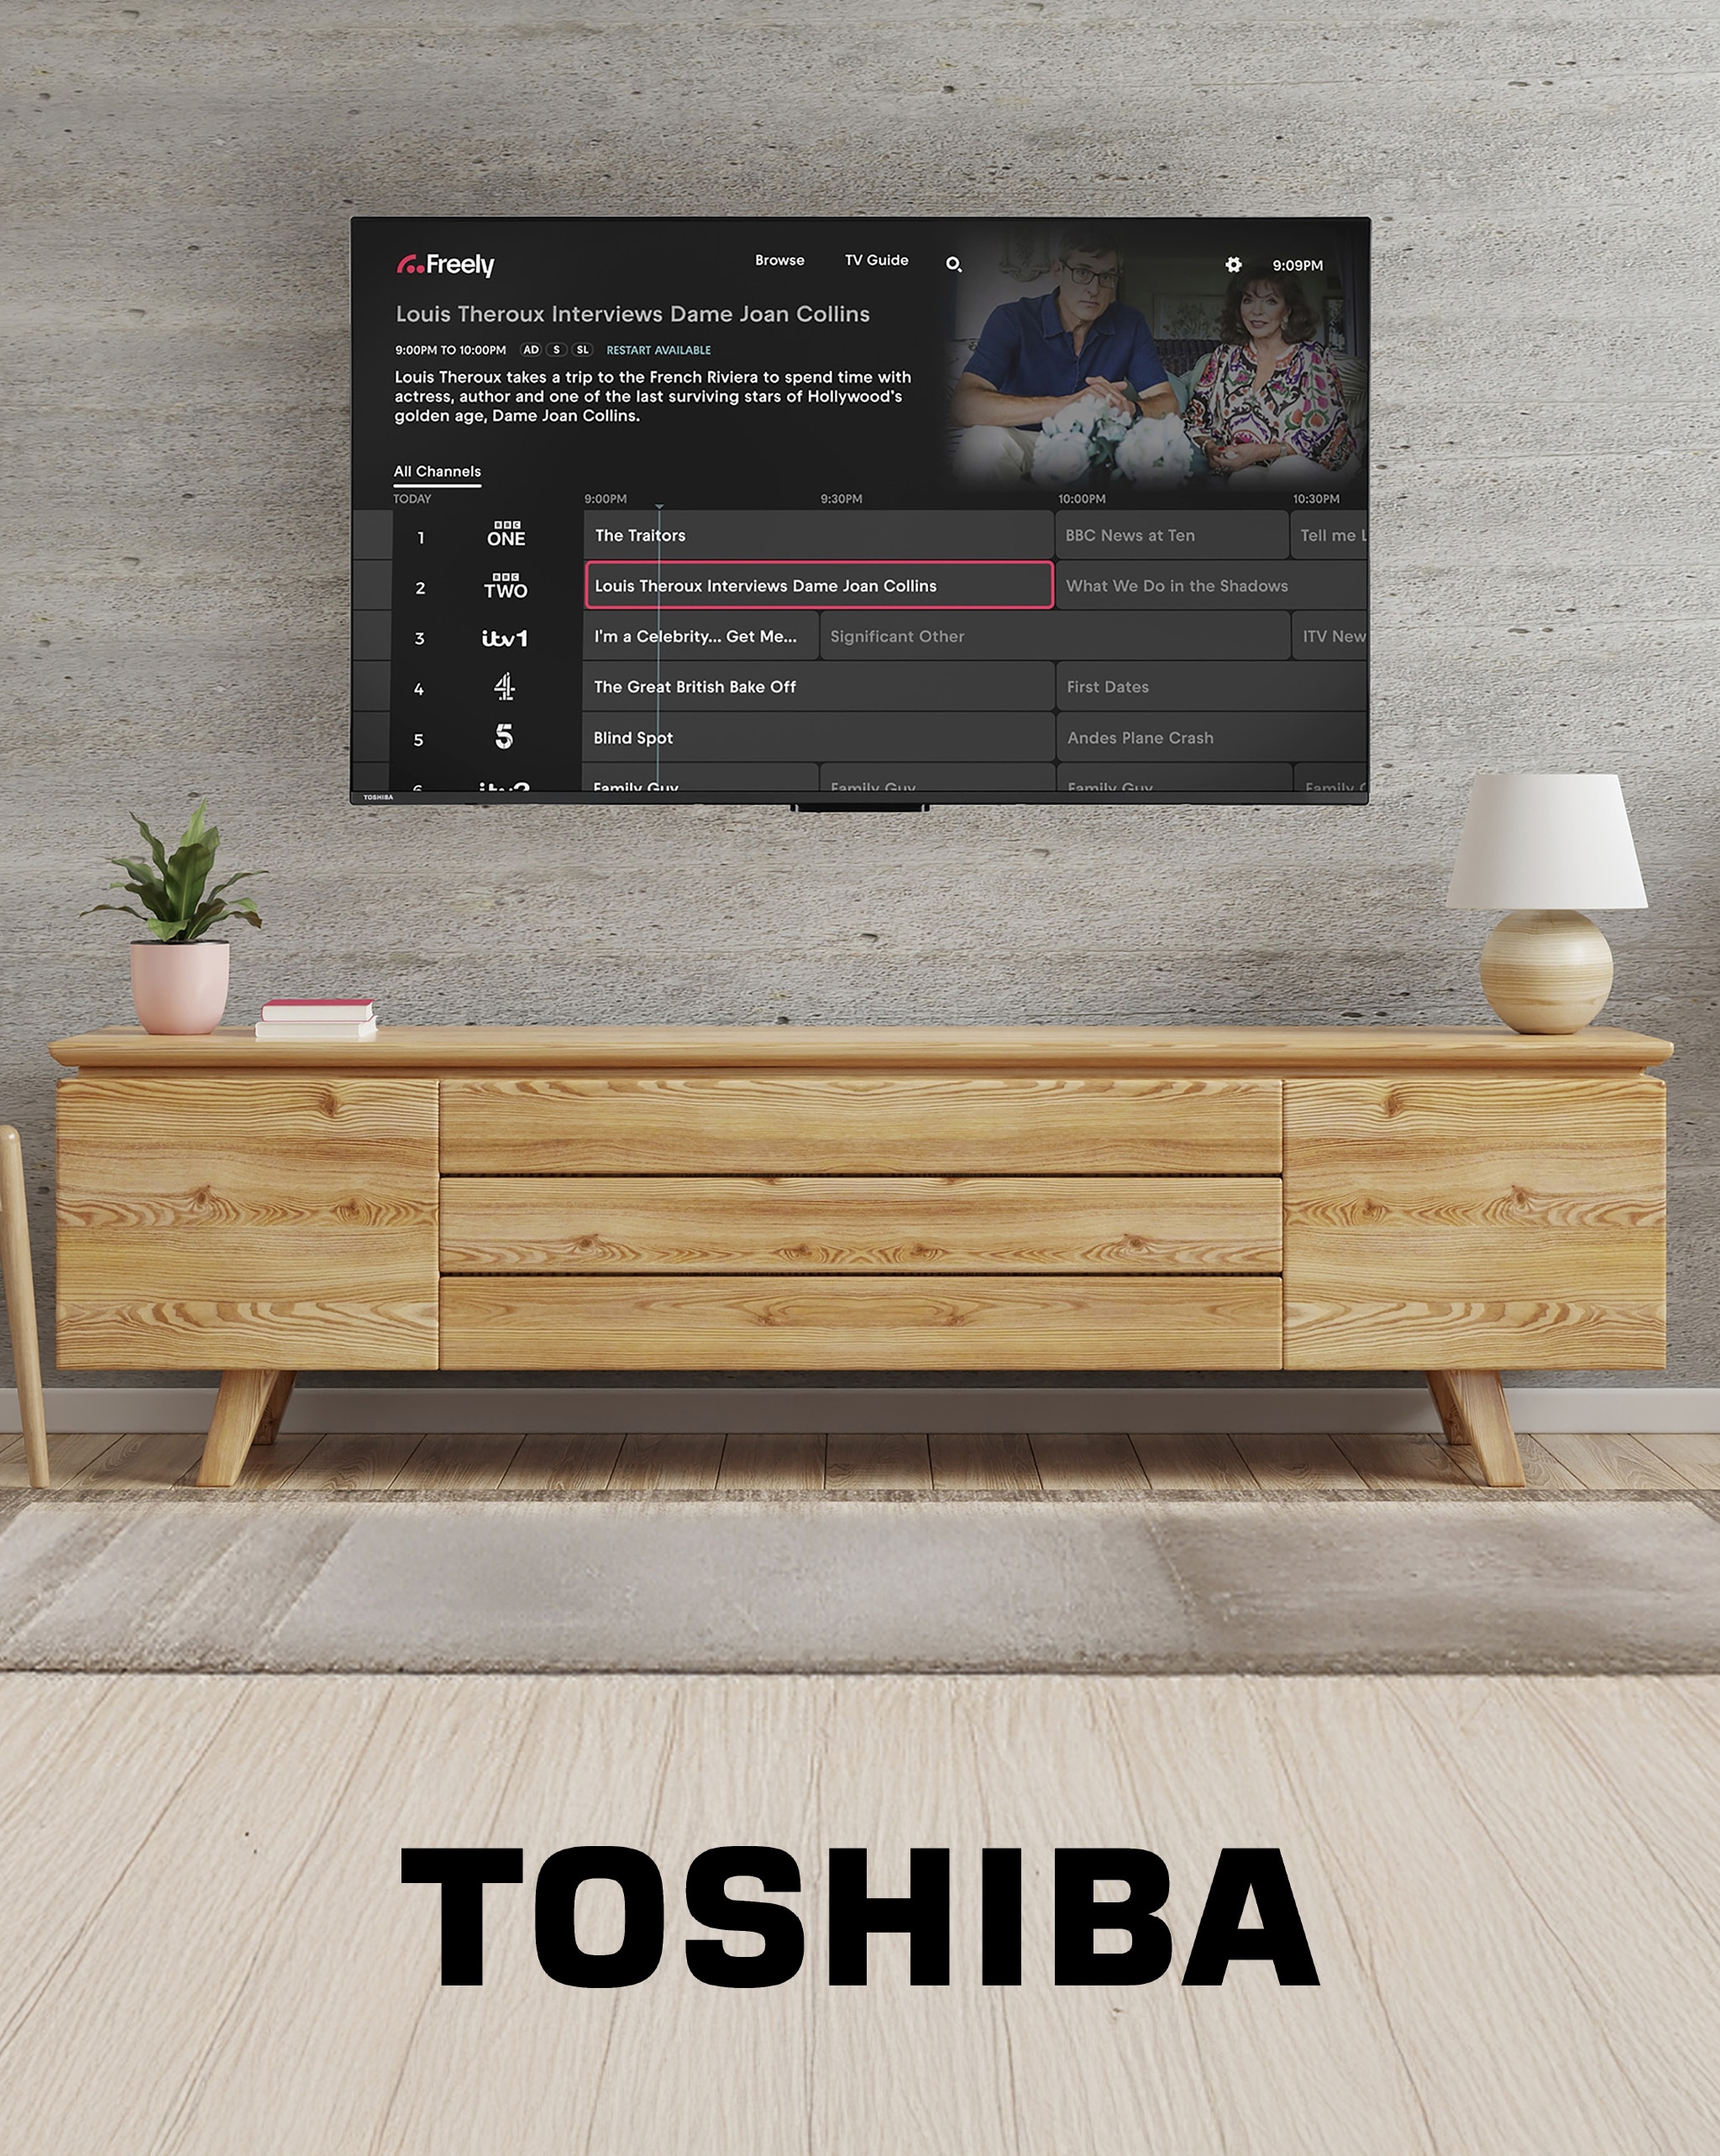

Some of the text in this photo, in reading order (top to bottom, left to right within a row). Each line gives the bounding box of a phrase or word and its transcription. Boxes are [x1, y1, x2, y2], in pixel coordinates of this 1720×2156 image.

[427, 254, 496, 279] Freely
[755, 254, 805, 266] Browse
[845, 254, 910, 266] TV Guide
[1272, 260, 1324, 271] 9:09PM
[396, 305, 870, 323] Louis Theroux Interviews Dame Joan Collins
[395, 344, 506, 355] 9:00PM TO 10:00PM
[523, 344, 539, 354] AD
[553, 344, 560, 354] S
[576, 344, 590, 354] SL
[606, 345, 711, 355] RESTART AVAILABLE
[395, 370, 911, 386] Louis Theroux takes a trip to the French Riviera to spend time with
[395, 389, 903, 407] actress, author and one of the last surviving stars of Hollywood's
[394, 408, 641, 425] golden age, Dame Joan Collins.
[393, 464, 482, 478] All Channels
[392, 493, 432, 504] TODAY
[584, 493, 627, 504] 9:00PM
[821, 493, 863, 504] 9:30PM
[1058, 493, 1106, 504] 10:00PM
[1293, 493, 1340, 504] 10:30PM
[494, 520, 522, 530] BBC
[417, 531, 424, 544] 1
[487, 531, 526, 547] ONE
[595, 528, 686, 543] The Traitors
[1066, 528, 1195, 542] BBC News at Ten
[1300, 528, 1327, 542] Tell
[1332, 532, 1356, 542] me
[492, 572, 520, 582] BBC
[416, 581, 426, 595] 2
[483, 584, 528, 599] TWO
[595, 579, 937, 593] Louis Theroux Interviews Dame Joan Collins
[1066, 579, 1288, 593] What We Do in the Shadows
[415, 632, 425, 645] 3
[482, 629, 527, 648] itv1
[595, 628, 797, 646] I'm a Celebrity... Get Me...
[831, 629, 965, 646] Significant Other
[1303, 629, 1366, 643] ITV New
[413, 682, 424, 696] 4
[493, 671, 516, 701] 4
[594, 679, 797, 694] The Great British Bake Off
[1067, 680, 1150, 694] First Dates
[413, 733, 424, 747] 5
[495, 723, 514, 750] 5
[594, 731, 674, 748] Blind Spot
[1067, 731, 1214, 745] Andes Plane Crash
